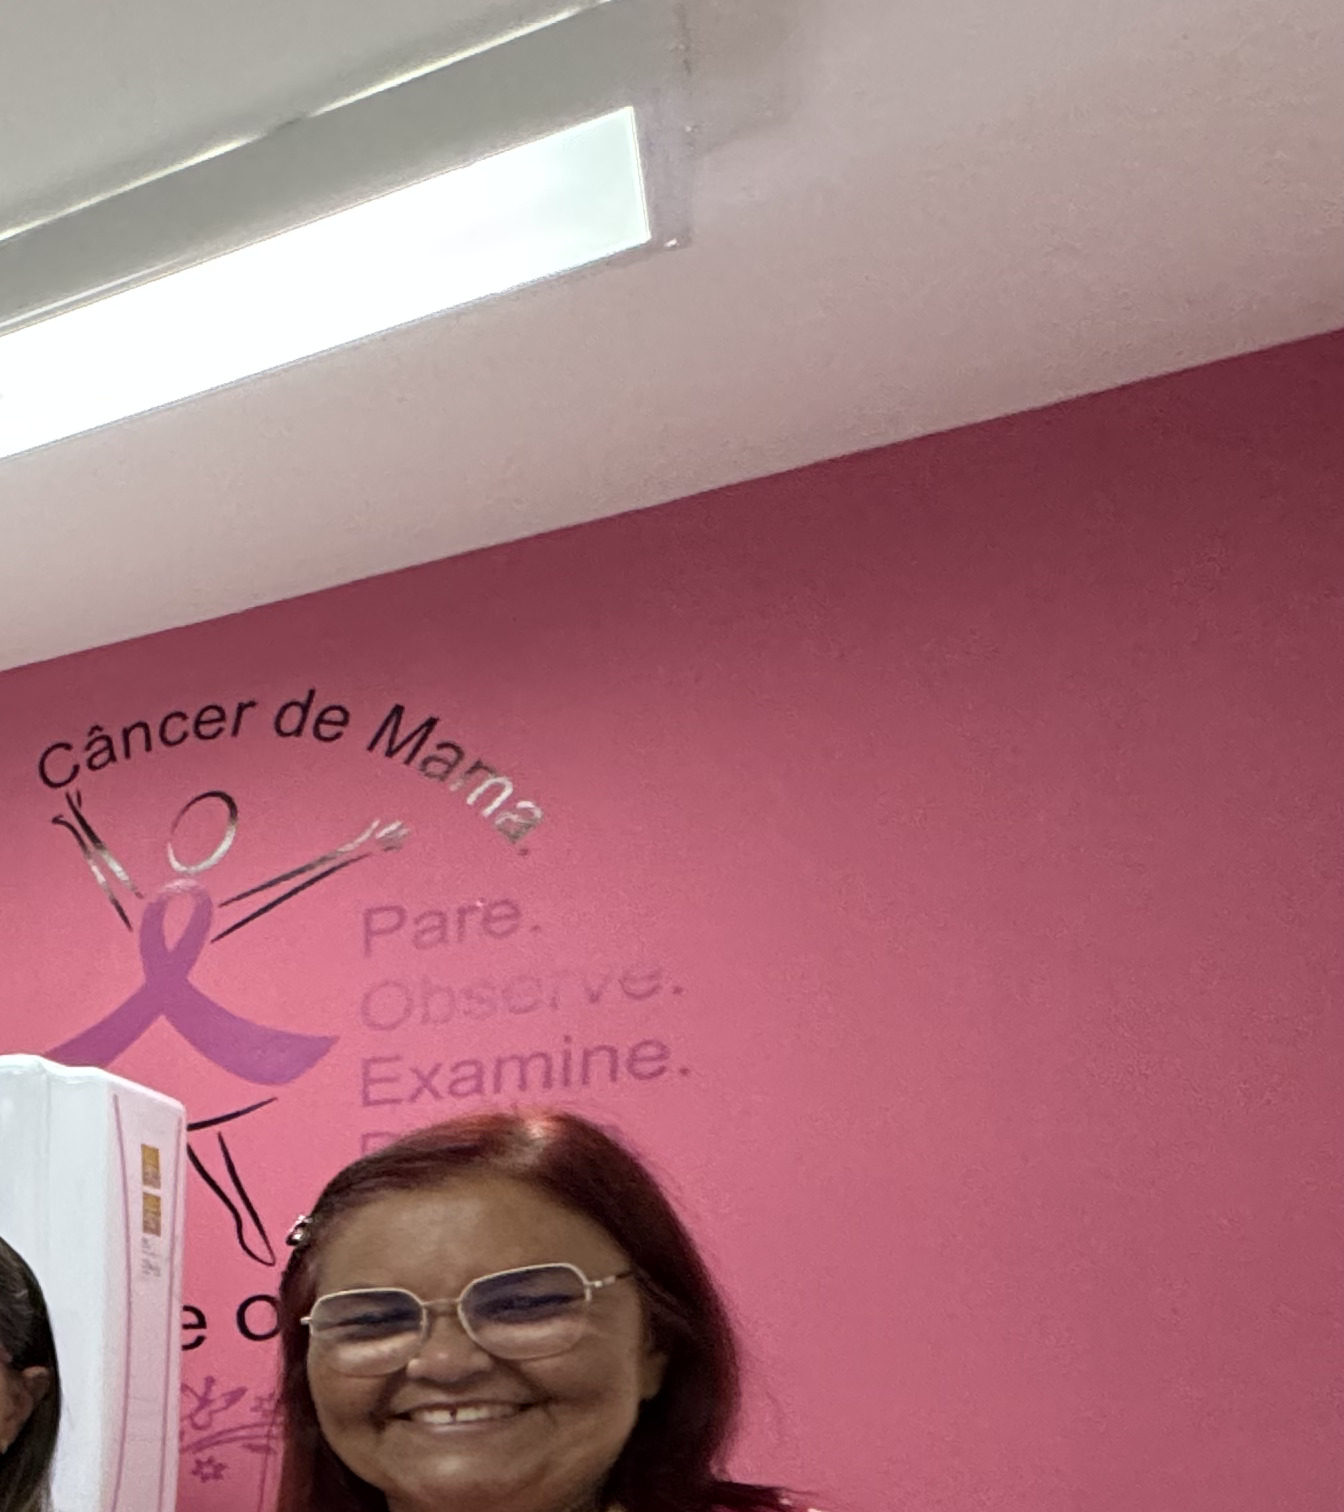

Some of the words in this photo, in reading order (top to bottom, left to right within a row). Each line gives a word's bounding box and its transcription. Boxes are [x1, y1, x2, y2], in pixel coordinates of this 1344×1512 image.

[37, 697, 257, 789] Câncer
[273, 688, 351, 742] de
[364, 898, 542, 957] Pare.
[362, 965, 685, 1032] Observe.
[362, 1034, 691, 1107] Examine.
